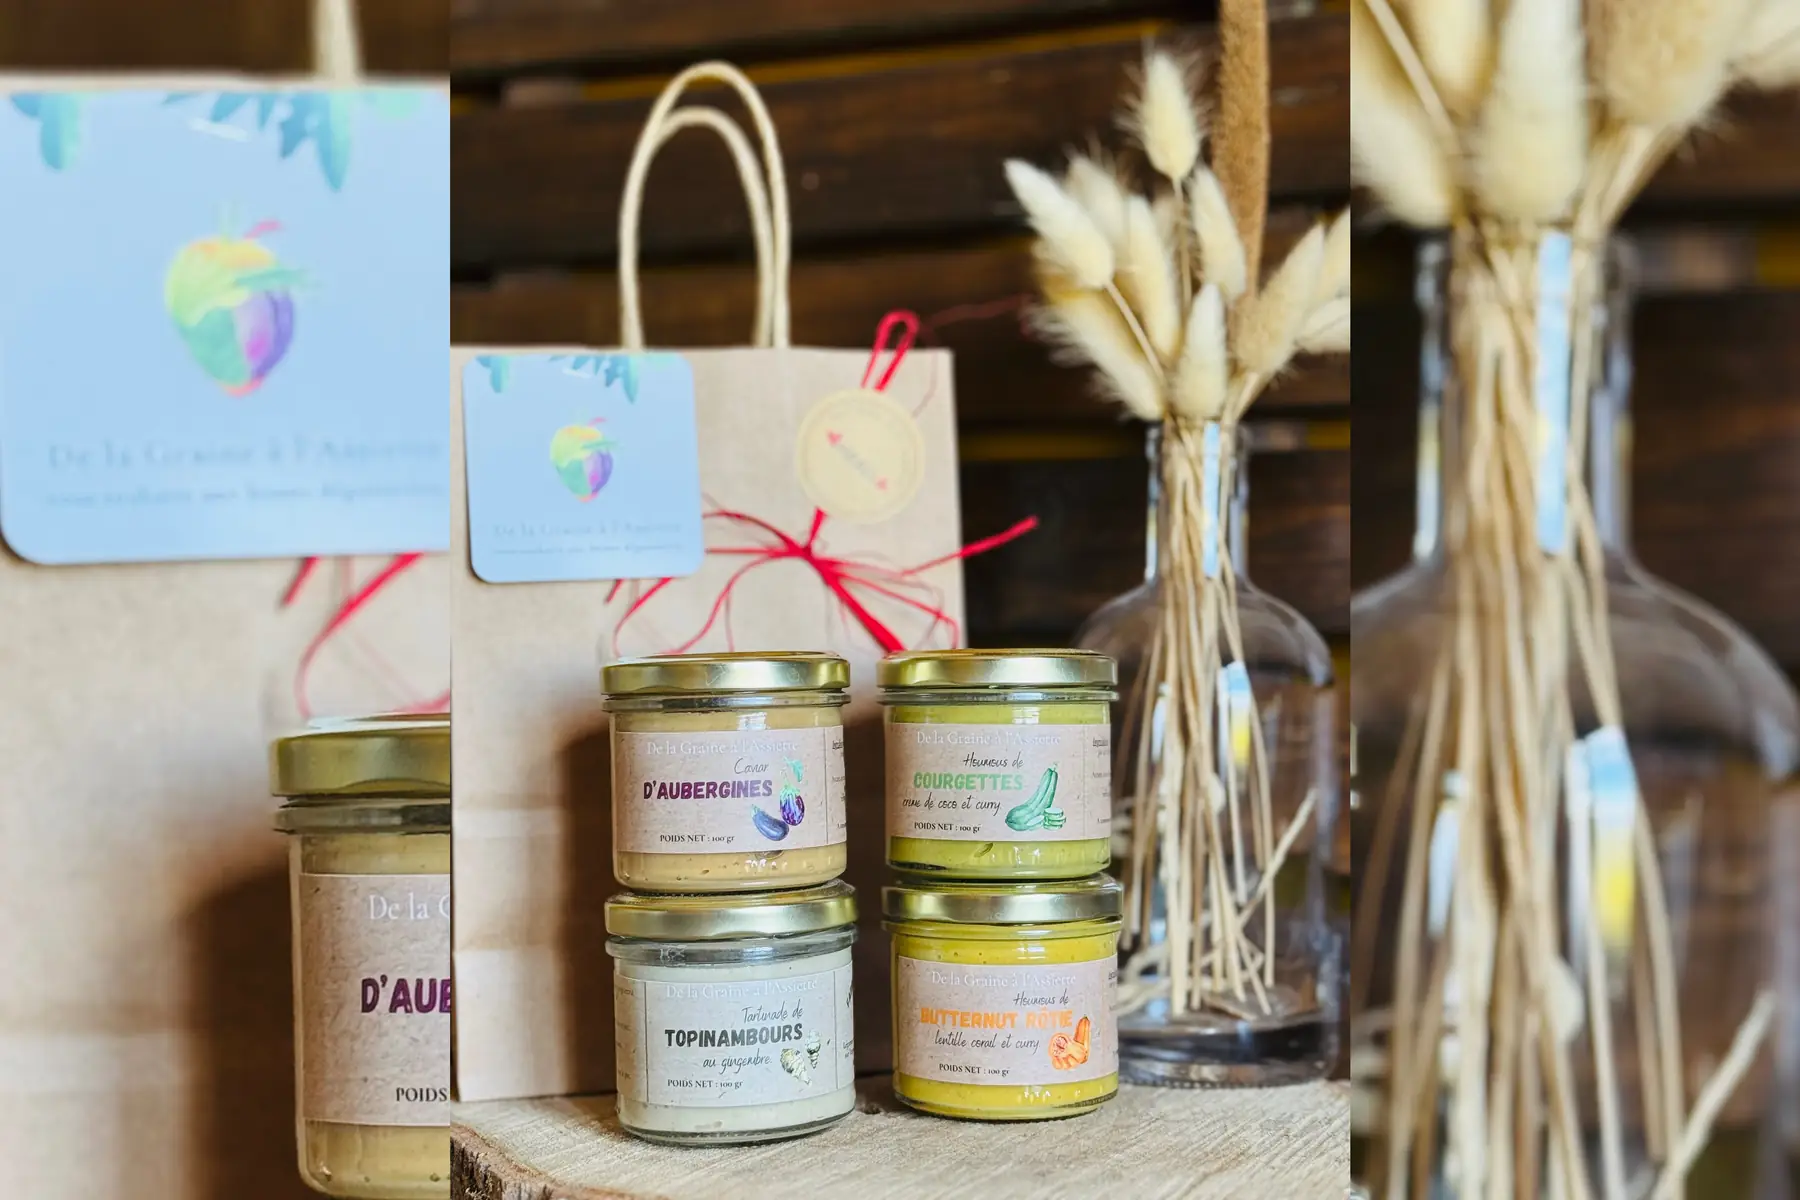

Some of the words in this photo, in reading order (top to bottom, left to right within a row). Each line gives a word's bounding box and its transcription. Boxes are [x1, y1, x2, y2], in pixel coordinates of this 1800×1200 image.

[917, 731, 931, 744] De
[934, 730, 944, 744] la
[947, 731, 991, 745] Graine
[647, 741, 664, 755] De
[666, 740, 677, 755] la
[680, 740, 726, 755] Graine
[734, 757, 769, 775] Caviar
[963, 751, 1008, 767] Houmous
[1012, 751, 1024, 768] de
[643, 779, 773, 800] D'AUBERGINES
[914, 772, 1024, 791] COURGETTES
[924, 792, 934, 810] de
[938, 799, 958, 810] coco
[961, 795, 974, 810] et
[914, 821, 936, 831] POIDS
[937, 823, 953, 831] NET
[972, 824, 981, 834] gr
[660, 834, 685, 843] POIDS
[687, 834, 705, 842] NET
[726, 835, 735, 845] gr
[369, 894, 399, 920] De
[409, 892, 430, 920] la
[932, 971, 947, 985] De
[950, 971, 960, 985] la
[964, 973, 1008, 987] Graine
[666, 985, 682, 999] De
[687, 984, 698, 998] la
[702, 984, 750, 999] Graine
[1013, 991, 1056, 1006] Houmous
[1059, 988, 1069, 1006] de
[741, 1000, 788, 1024] Tartinade
[791, 998, 804, 1019] de
[920, 1007, 1019, 1029] BUTTERNUT
[1026, 1006, 1073, 1030] RÔTIE
[664, 1023, 803, 1048] TOPINAMBOURS
[935, 1029, 967, 1048] lentille
[971, 1034, 997, 1048] corail
[1001, 1033, 1013, 1049] et
[702, 1058, 716, 1068] au
[939, 1063, 963, 1073] POIDS
[964, 1066, 981, 1075] NET
[1001, 1068, 1010, 1077] gr
[667, 1079, 693, 1088] POIDS
[695, 1080, 713, 1088] NET
[734, 1080, 744, 1090] gr
[396, 1087, 448, 1102] POIDS
